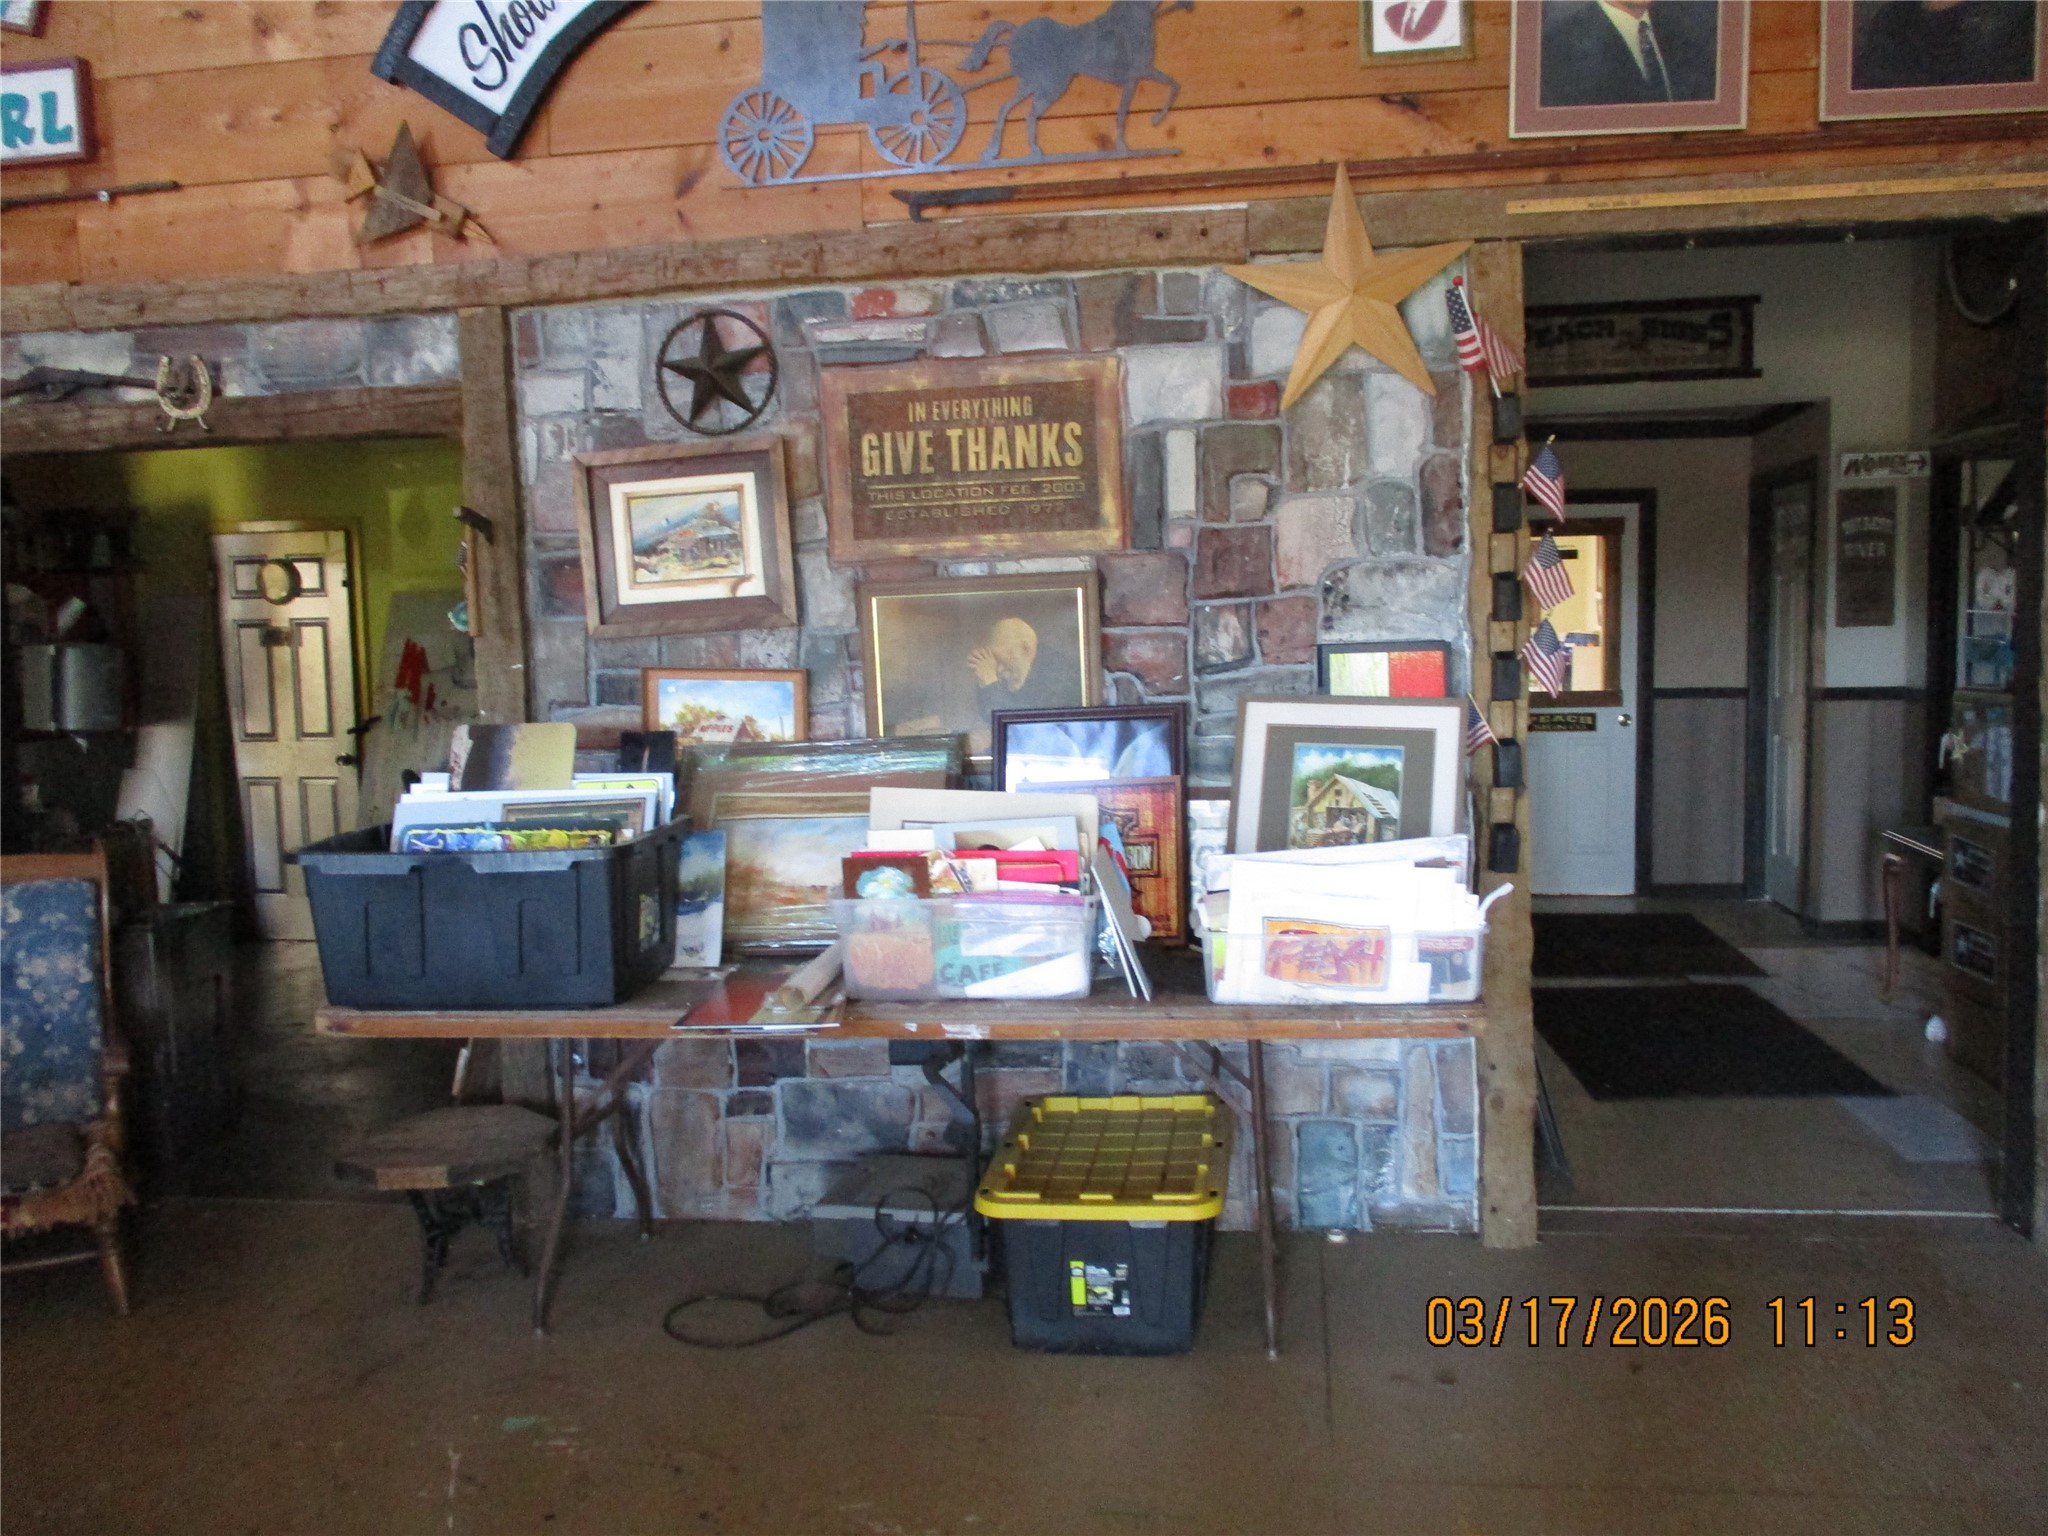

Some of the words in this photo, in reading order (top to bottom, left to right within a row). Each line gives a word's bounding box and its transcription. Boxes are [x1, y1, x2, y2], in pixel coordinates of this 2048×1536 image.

[908, 401, 927, 422] IN
[932, 395, 1033, 421] EVERYTHING
[861, 429, 935, 477] GIVE
[946, 421, 1084, 472] THANKS
[868, 490, 905, 502] THIS
[911, 486, 994, 500] LOCATION
[1042, 481, 1086, 493] 2003
[884, 504, 1011, 521] ESTABLISHED
